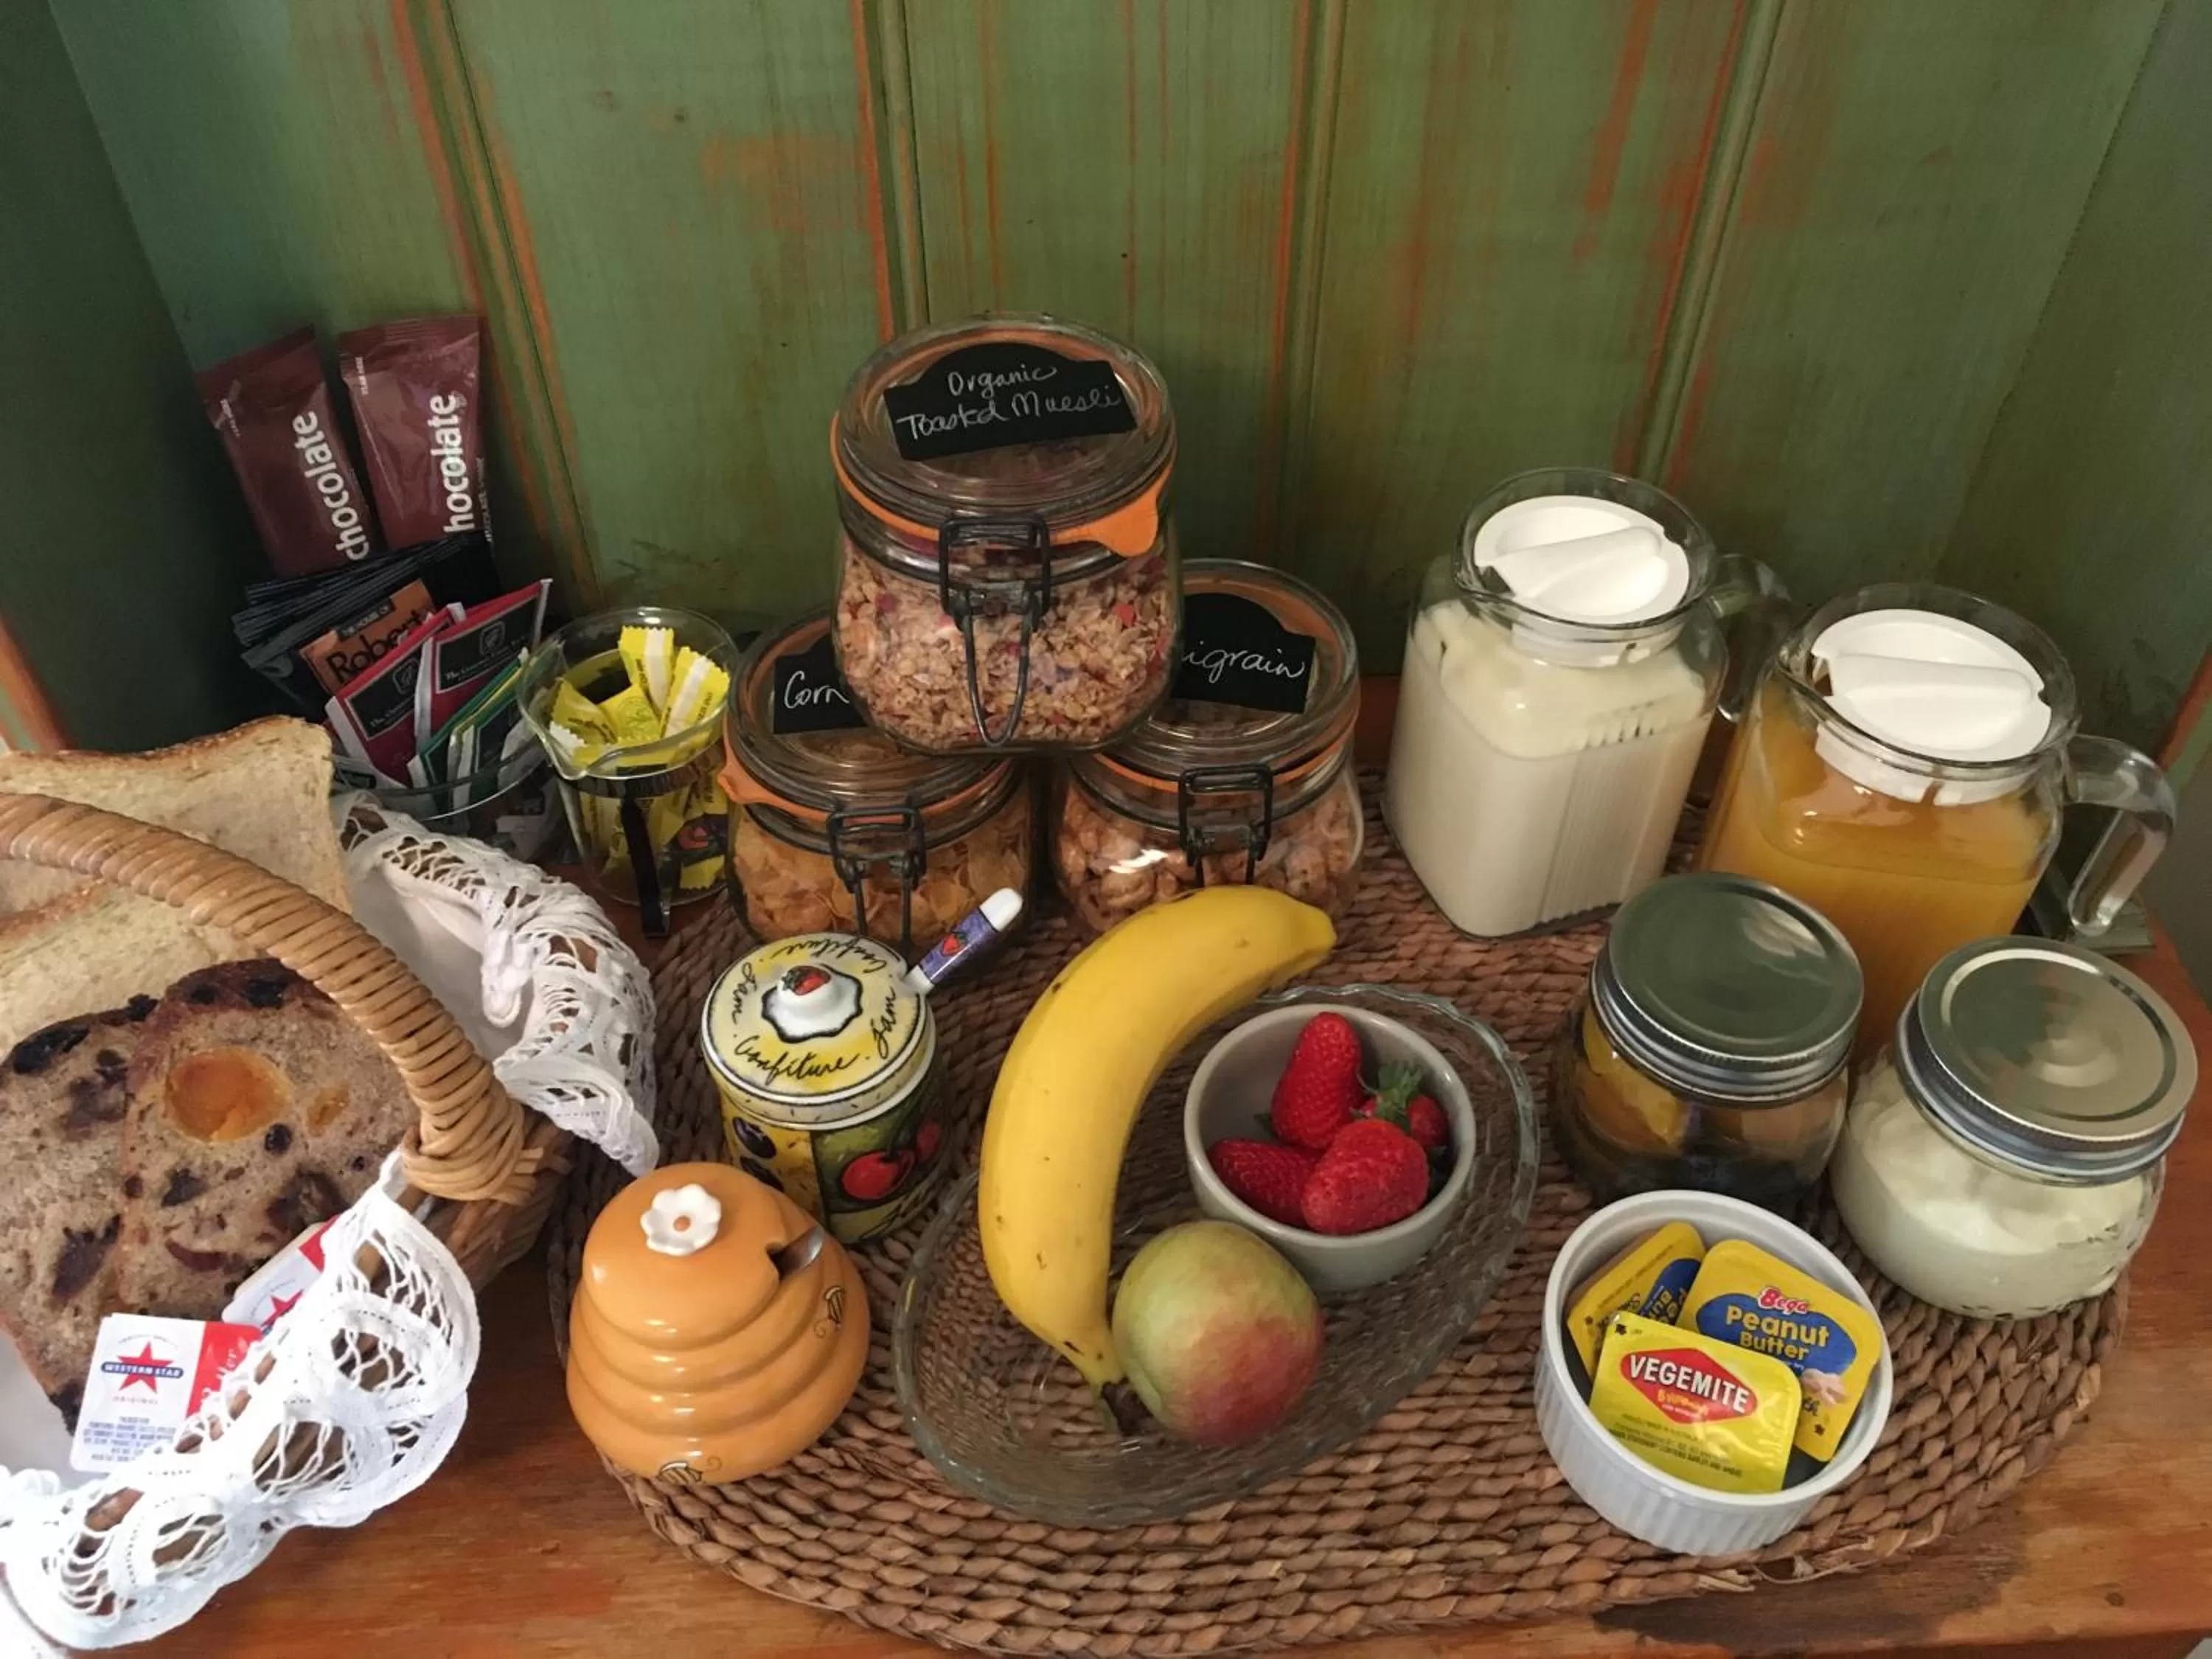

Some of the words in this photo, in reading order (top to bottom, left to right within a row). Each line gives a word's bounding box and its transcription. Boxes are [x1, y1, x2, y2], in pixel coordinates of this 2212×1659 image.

[947, 364, 1057, 398] Organic
[1011, 386, 1122, 418] Muesli
[427, 394, 476, 533] hocolate
[292, 410, 369, 561] chocolate
[1181, 640, 1305, 684] igrain
[784, 670, 850, 709] Corn
[734, 1034, 860, 1086] Confiture
[1758, 1286, 1809, 1315] Bega
[1740, 1330, 1809, 1360] Butter
[1630, 1354, 1750, 1413] VEGEMITE
